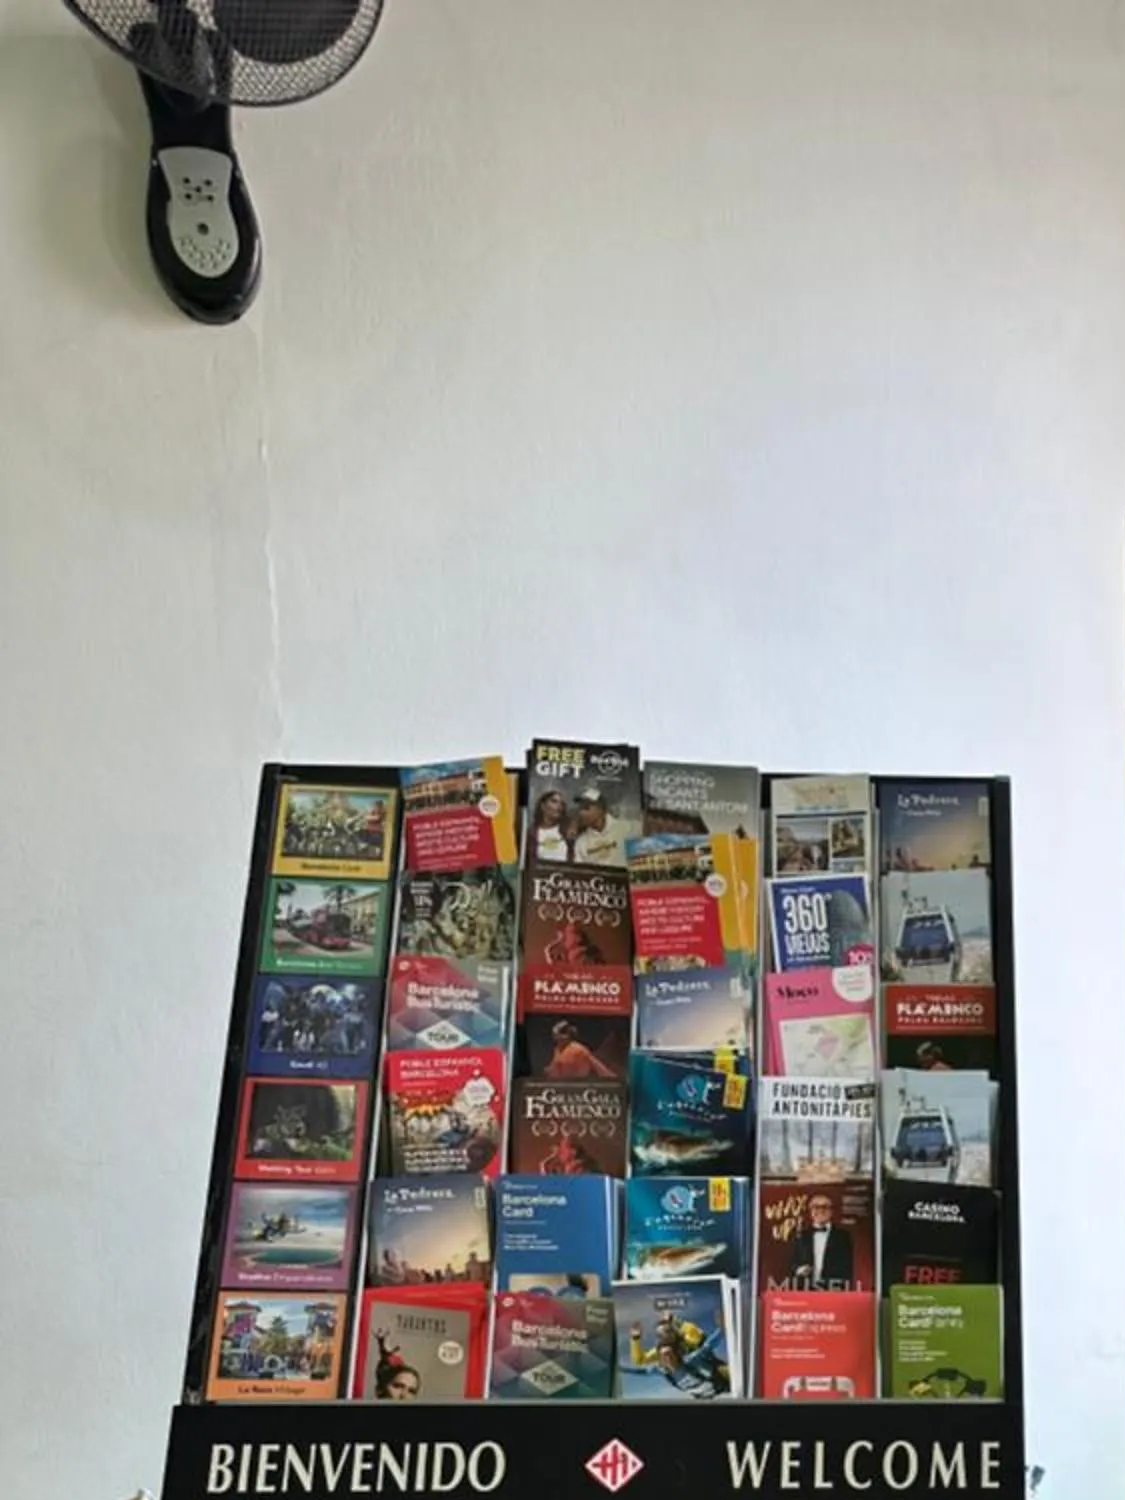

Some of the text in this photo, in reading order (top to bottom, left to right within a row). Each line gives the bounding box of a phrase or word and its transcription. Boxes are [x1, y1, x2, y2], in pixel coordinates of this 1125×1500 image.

[536, 745, 586, 769] FREE
[536, 761, 581, 779] GIFT
[533, 879, 627, 909] FLAMENCO
[785, 932, 830, 956] VIEWS
[408, 981, 479, 998] Barcelona
[533, 980, 621, 995] FLAMENCO
[897, 1003, 984, 1016] FLAMENCO
[427, 1030, 459, 1041] TOUR
[525, 1096, 621, 1119] FLAMENCO
[384, 1187, 454, 1204] La Pedrera
[502, 1193, 567, 1207] Barcelona
[502, 1206, 534, 1218] Card
[765, 1193, 808, 1220] WAX
[914, 1201, 960, 1215] CASINO
[908, 1210, 967, 1224] BARCELONA
[905, 1266, 962, 1283] FREE
[770, 1309, 835, 1322] Barcelona
[898, 1304, 962, 1317] Barcelona
[511, 1319, 588, 1340] Barcelona
[770, 1322, 803, 1334] Card
[898, 1315, 933, 1329] Card
[532, 1371, 565, 1384] TOUR
[207, 1439, 1001, 1493] BIENVENIDO WELCOME
